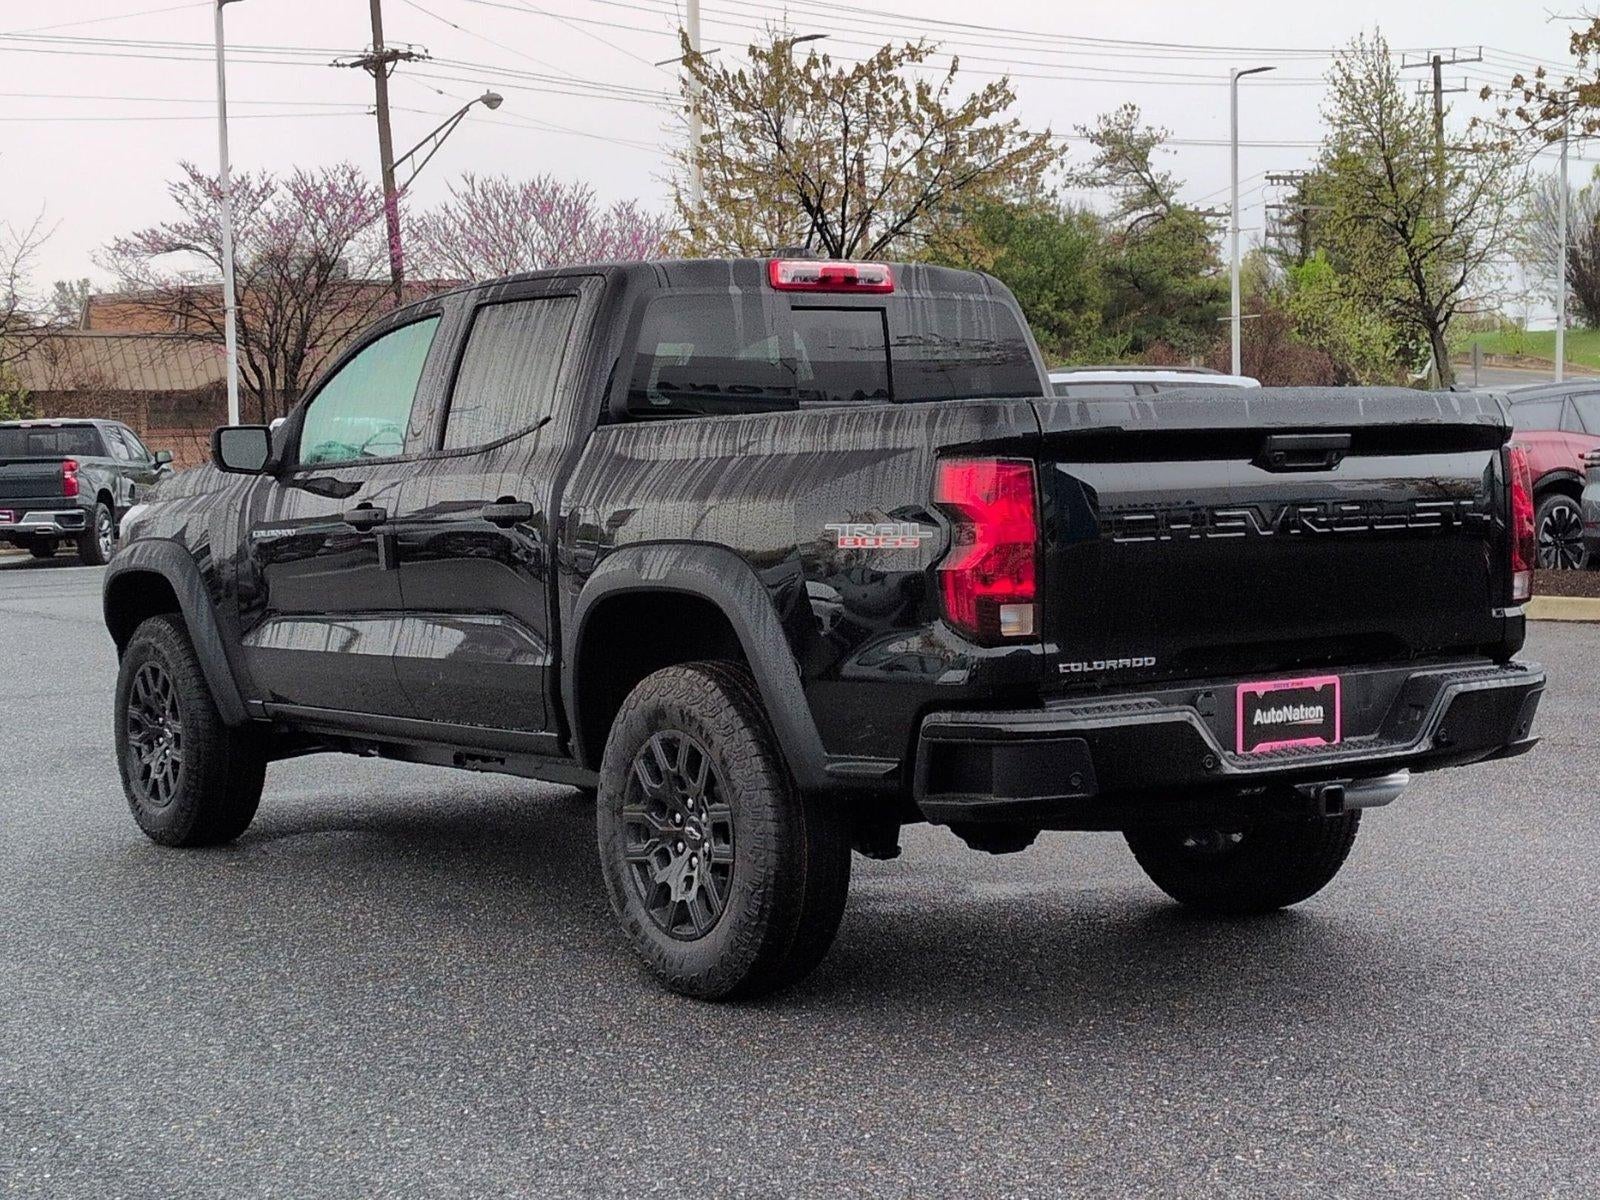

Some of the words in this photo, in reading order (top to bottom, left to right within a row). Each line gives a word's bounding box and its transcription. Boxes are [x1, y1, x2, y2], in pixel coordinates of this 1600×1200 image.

[825, 523, 933, 537] TRAIL
[838, 536, 920, 548] BOSS
[1059, 657, 1156, 673] COLORADO
[1253, 704, 1323, 725] AutoNation
